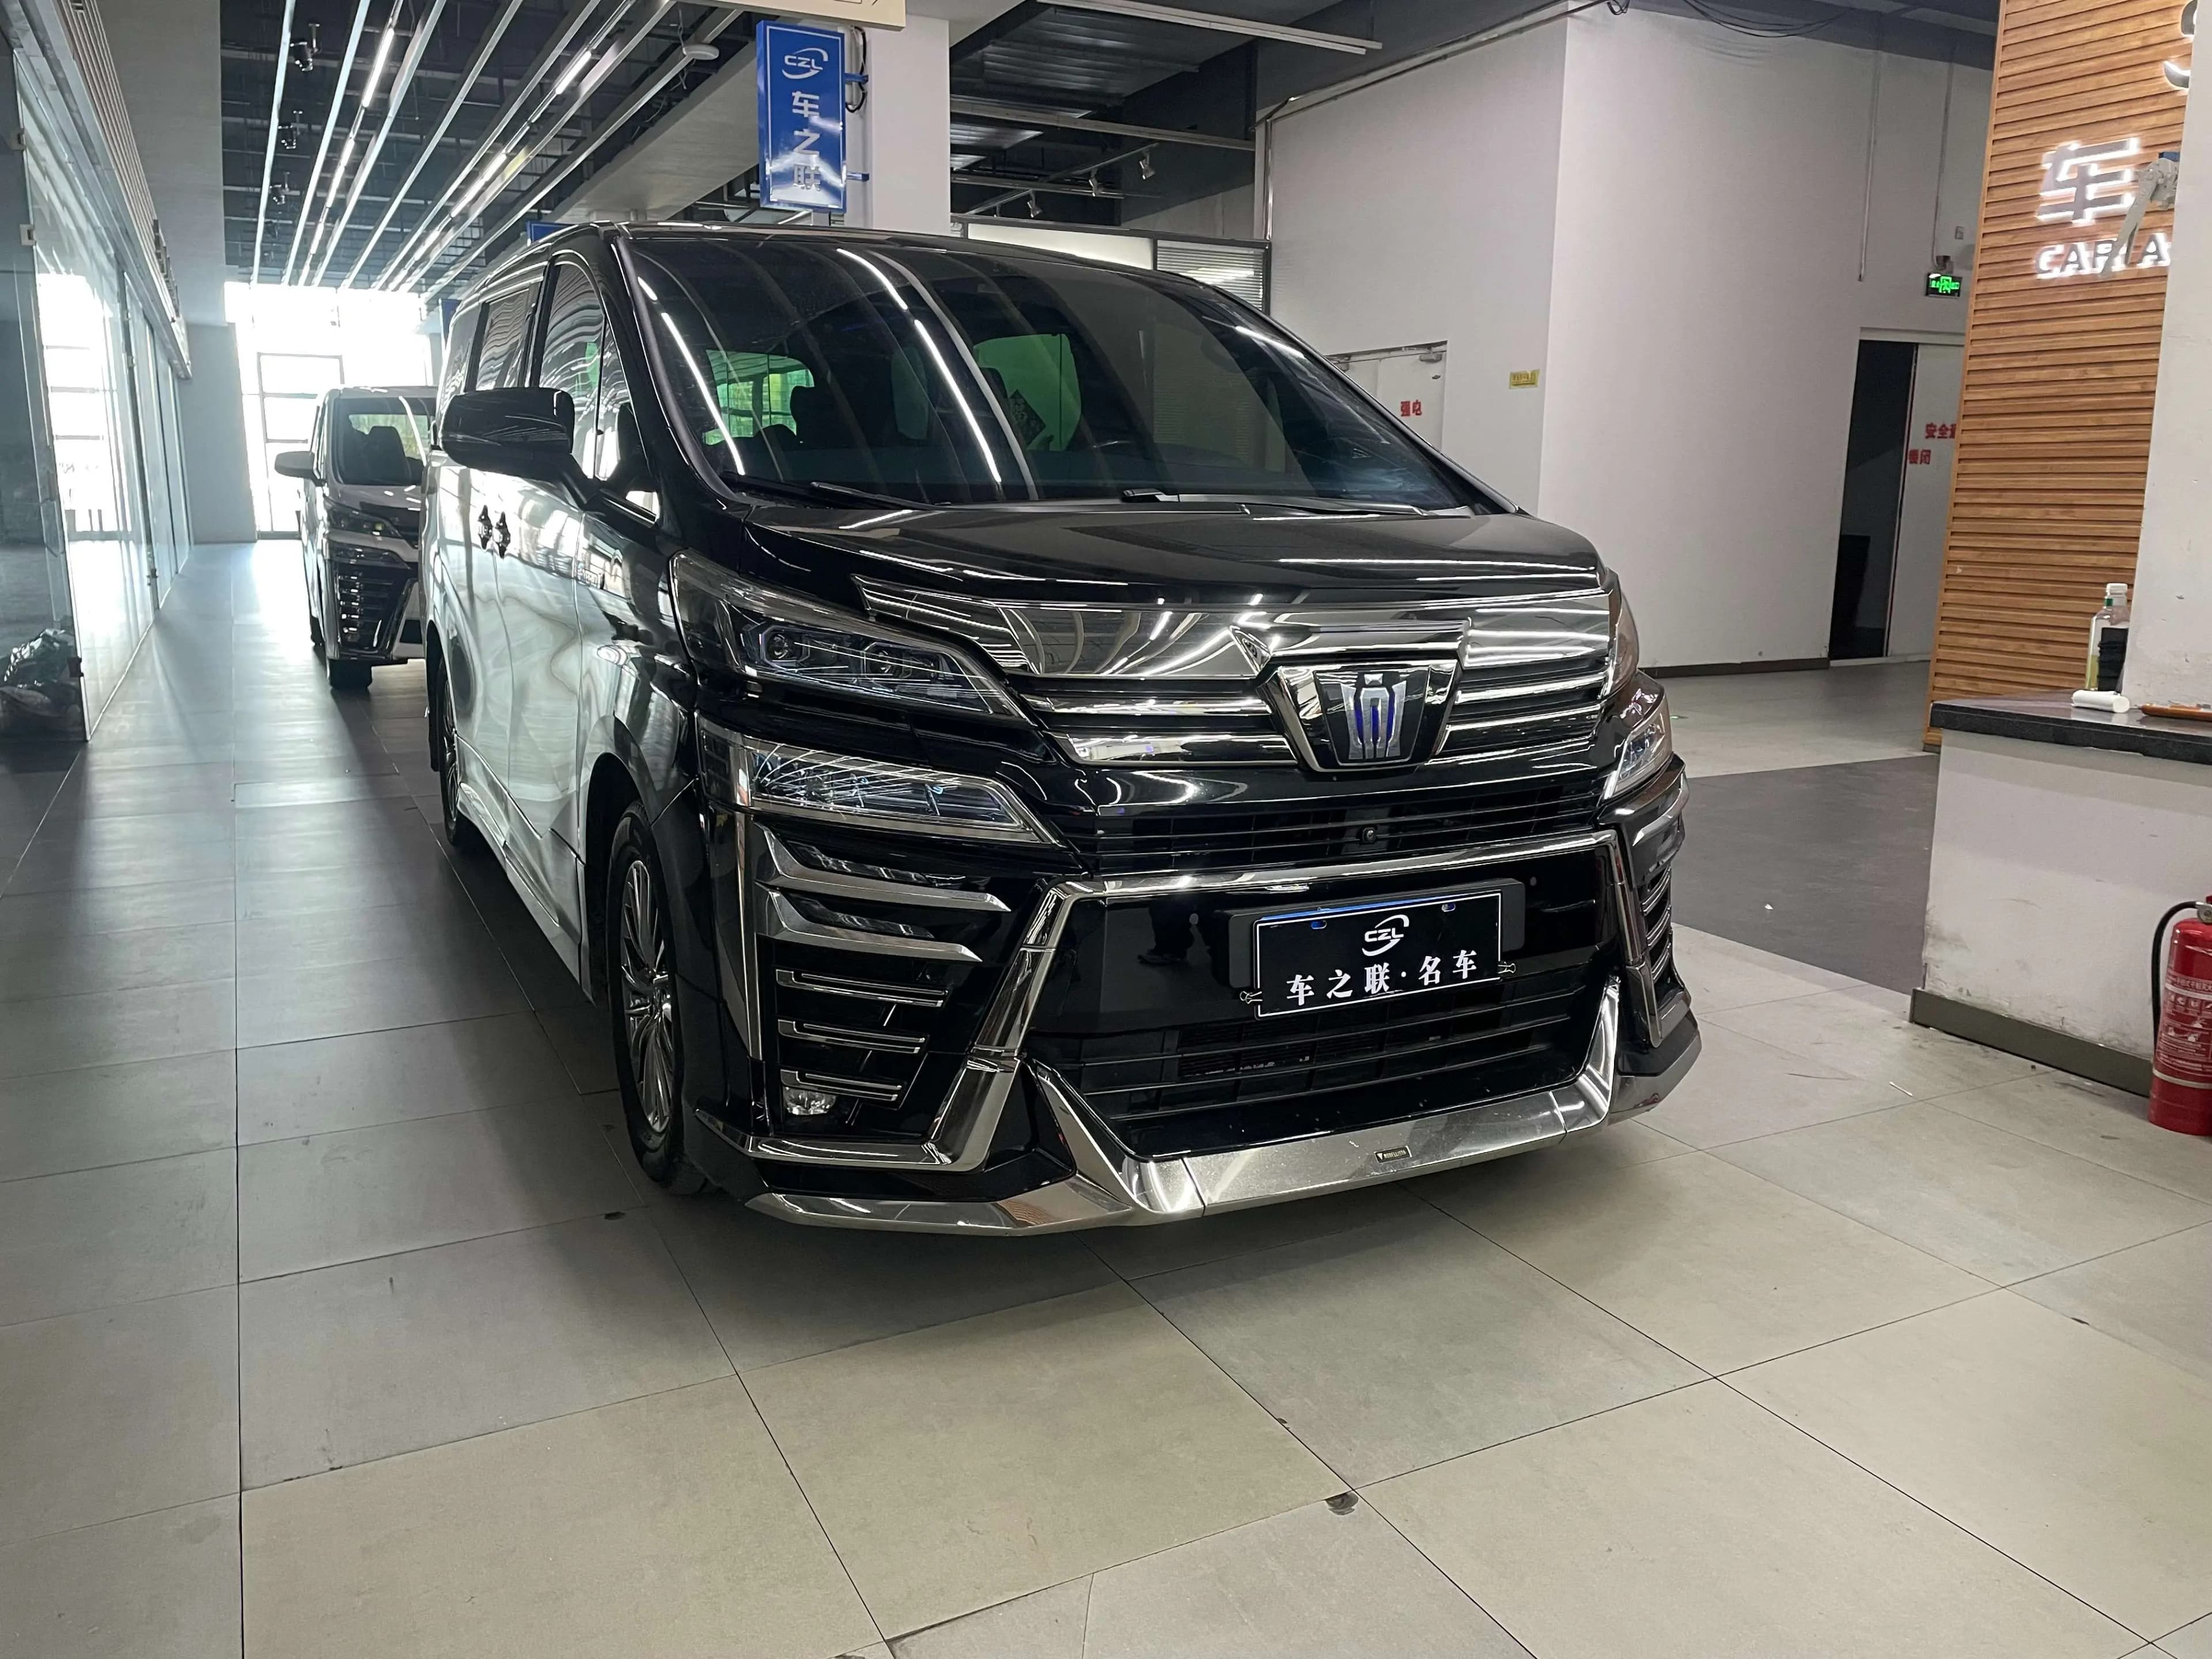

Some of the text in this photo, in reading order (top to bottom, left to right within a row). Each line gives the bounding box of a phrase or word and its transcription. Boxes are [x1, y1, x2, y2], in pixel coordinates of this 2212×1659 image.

[784, 55, 823, 70] CZL
[791, 90, 821, 191] 车之联
[2035, 137, 2139, 225] 车
[1365, 927, 1404, 942] CZL
